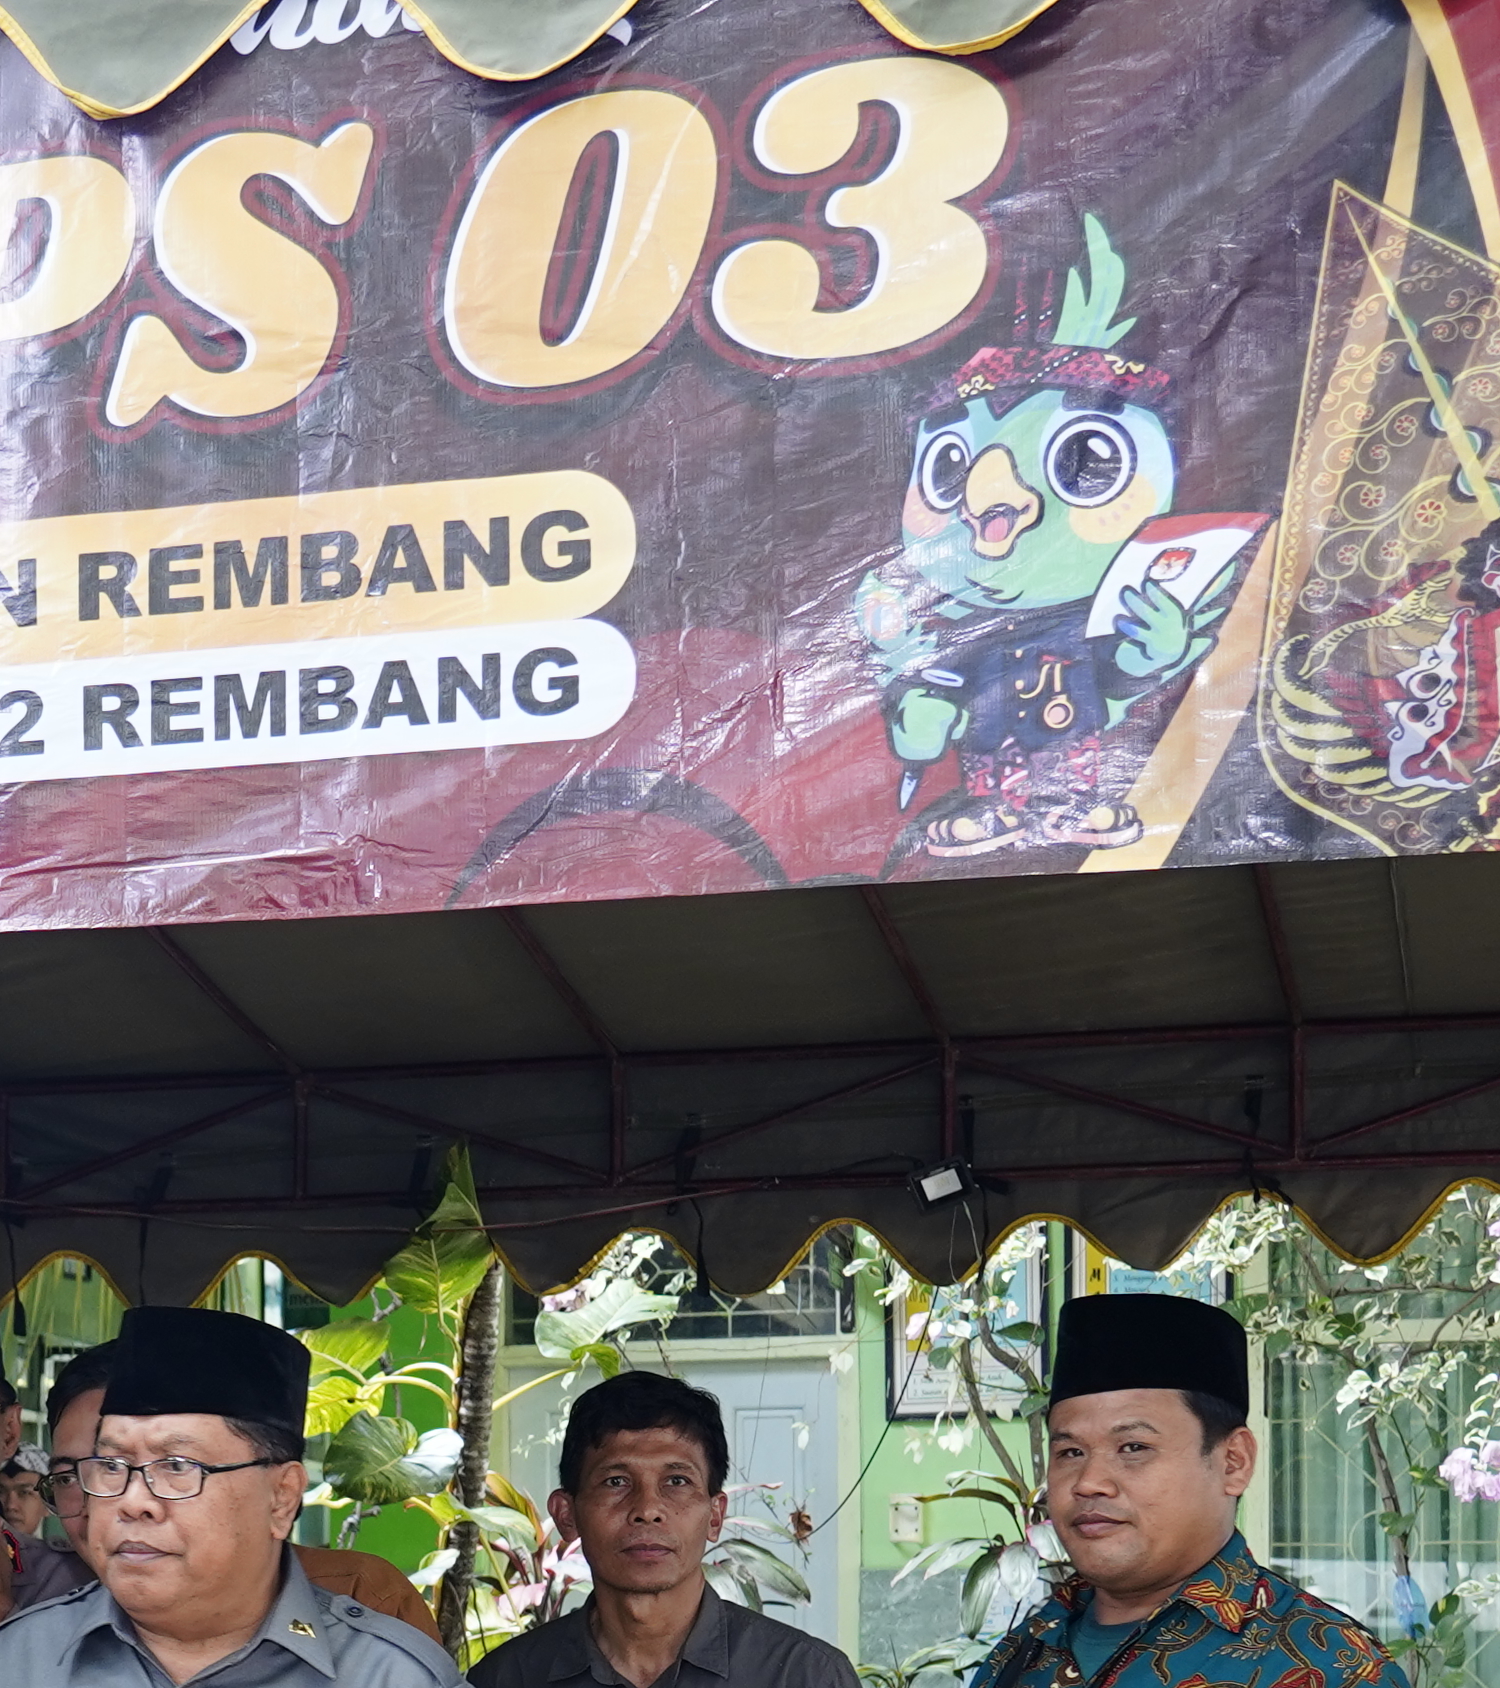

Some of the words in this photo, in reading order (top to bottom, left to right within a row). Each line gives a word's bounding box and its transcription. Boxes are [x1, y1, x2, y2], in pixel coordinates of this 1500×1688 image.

[442, 54, 1012, 392] 03
[74, 508, 598, 626] REMBANG
[80, 646, 584, 752] REMBANG
